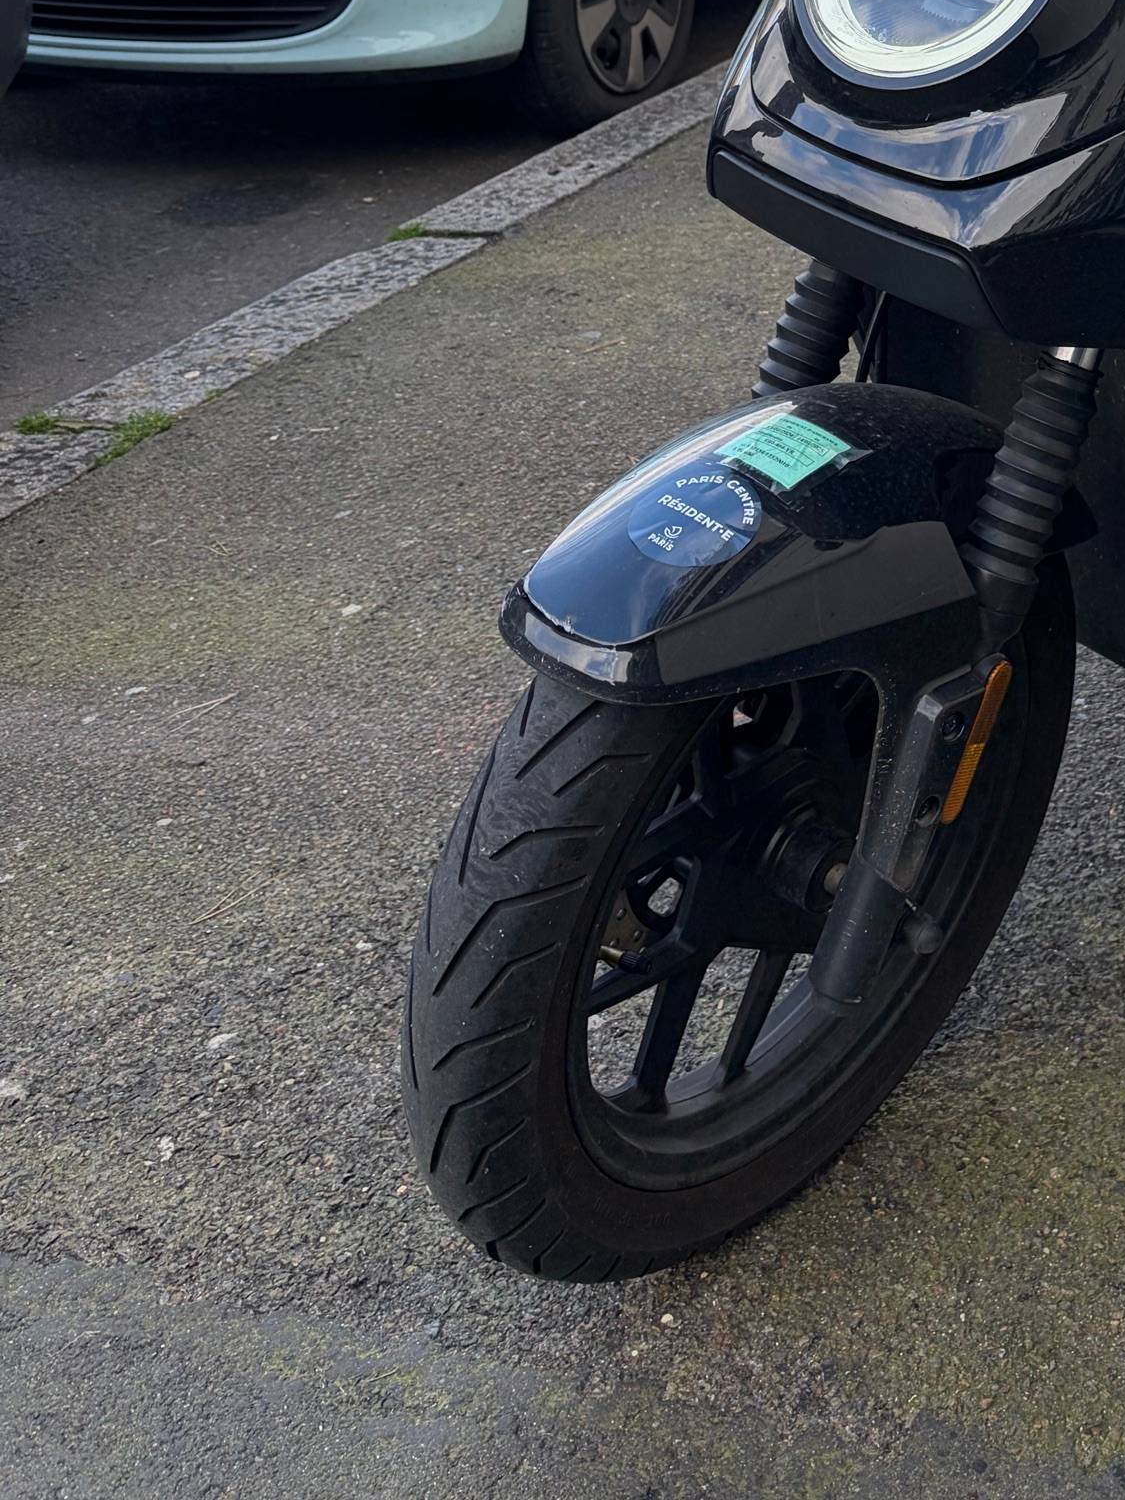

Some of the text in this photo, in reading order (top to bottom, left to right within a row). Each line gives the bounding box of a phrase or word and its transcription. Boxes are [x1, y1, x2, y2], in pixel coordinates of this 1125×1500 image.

[676, 475, 755, 525] PARIS CENTRE
[647, 533, 674, 552] PARIS
